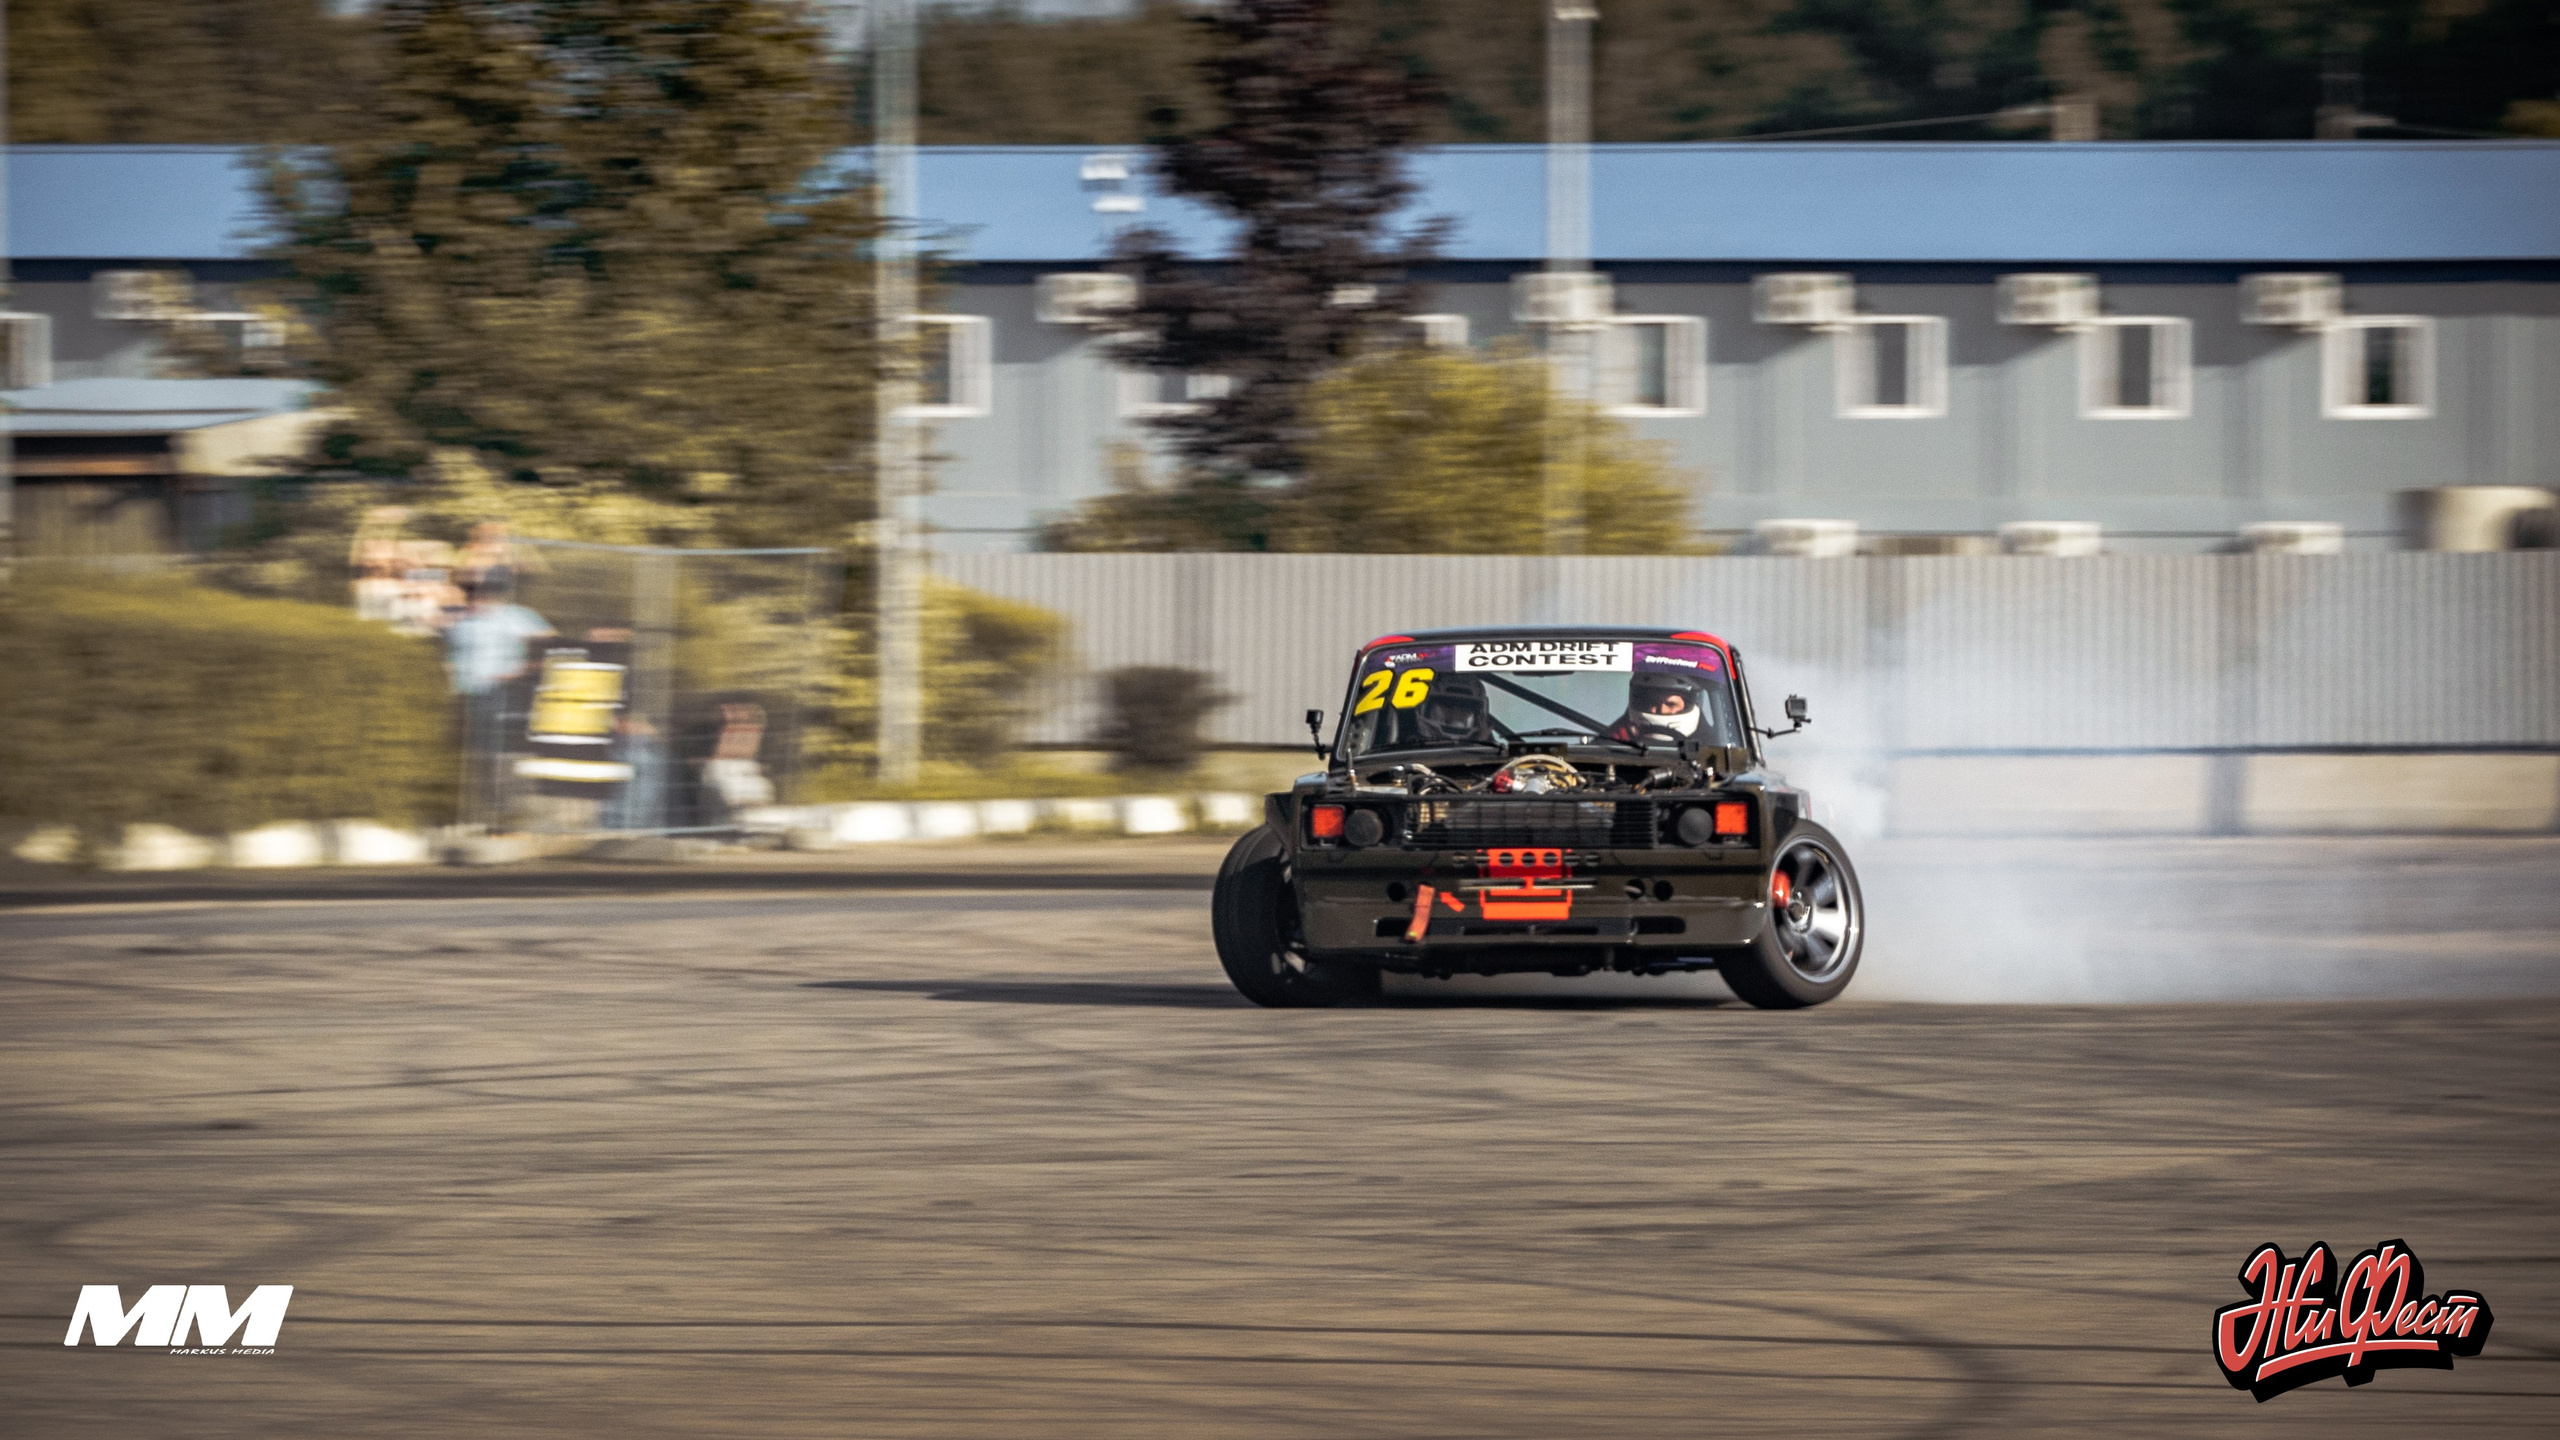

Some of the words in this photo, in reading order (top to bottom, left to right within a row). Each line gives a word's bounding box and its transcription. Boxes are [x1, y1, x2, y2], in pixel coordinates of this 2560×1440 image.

[1470, 643, 1532, 654] ADM
[1539, 642, 1619, 652] DRIFT
[1468, 654, 1618, 667] CONTEST
[1353, 668, 1434, 716] 26
